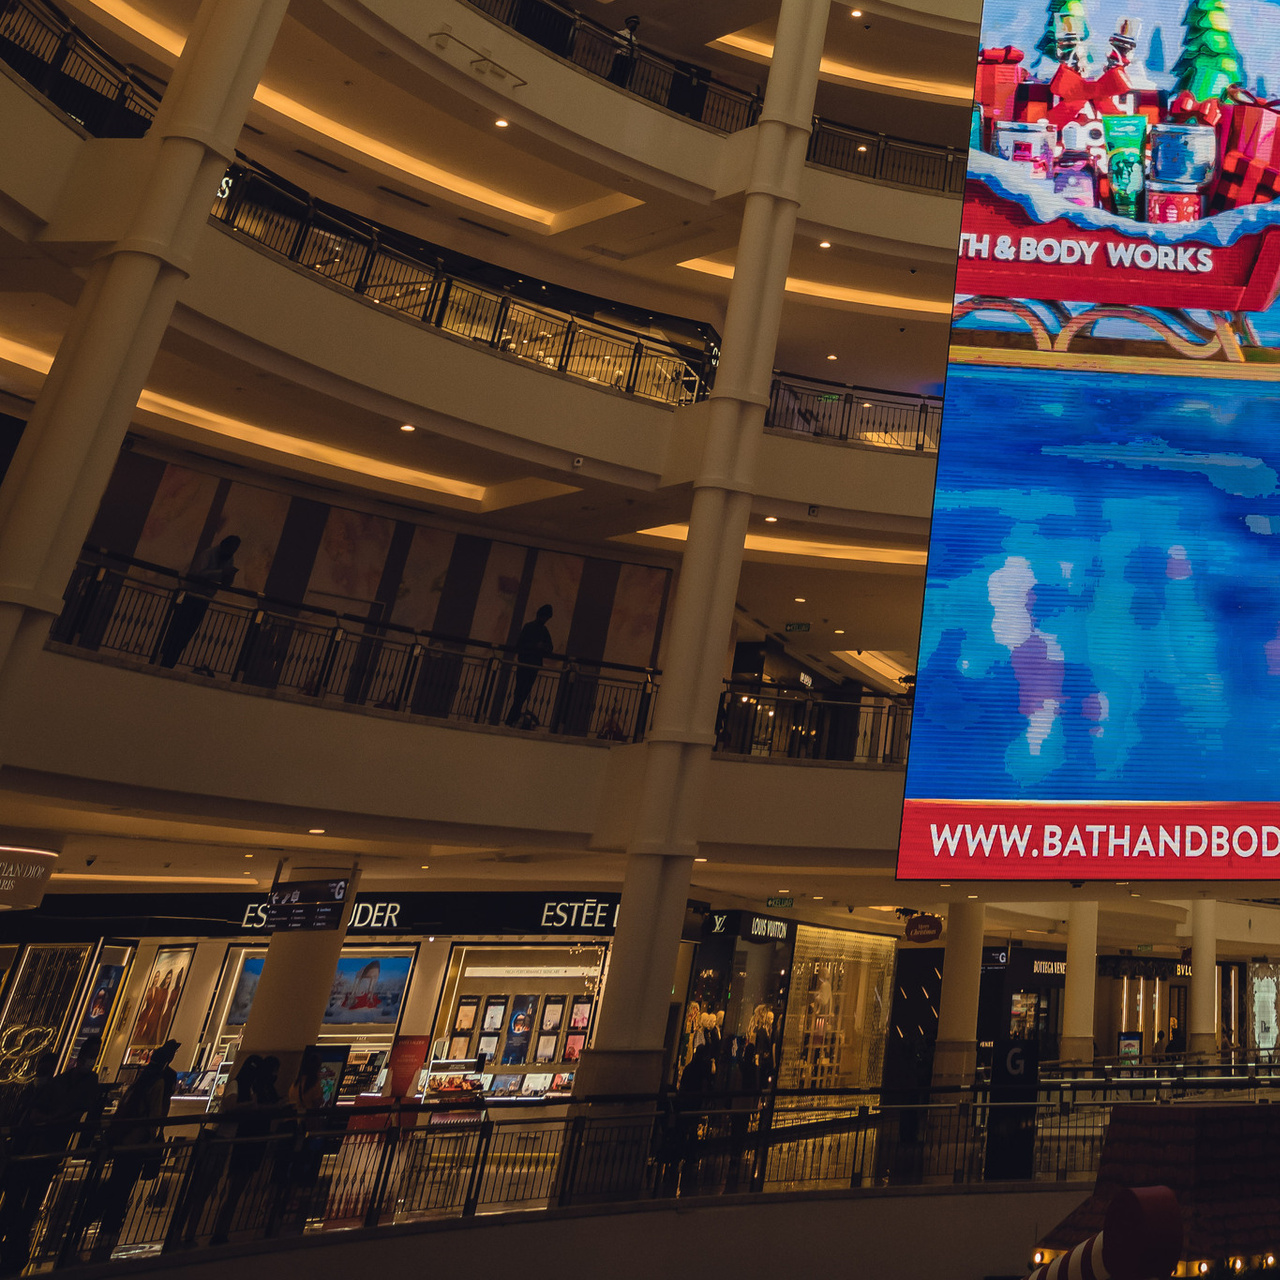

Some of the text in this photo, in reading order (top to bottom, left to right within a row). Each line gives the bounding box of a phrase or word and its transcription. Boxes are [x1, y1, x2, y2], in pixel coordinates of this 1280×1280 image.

[993, 235, 1016, 260] &
[1019, 237, 1100, 265] BODY
[1106, 243, 1214, 272] WORKS
[334, 881, 346, 900] G
[751, 917, 767, 936] LOUIS
[998, 952, 1007, 963] G
[1054, 962, 1066, 975] VENE
[1006, 1047, 1025, 1075] G
